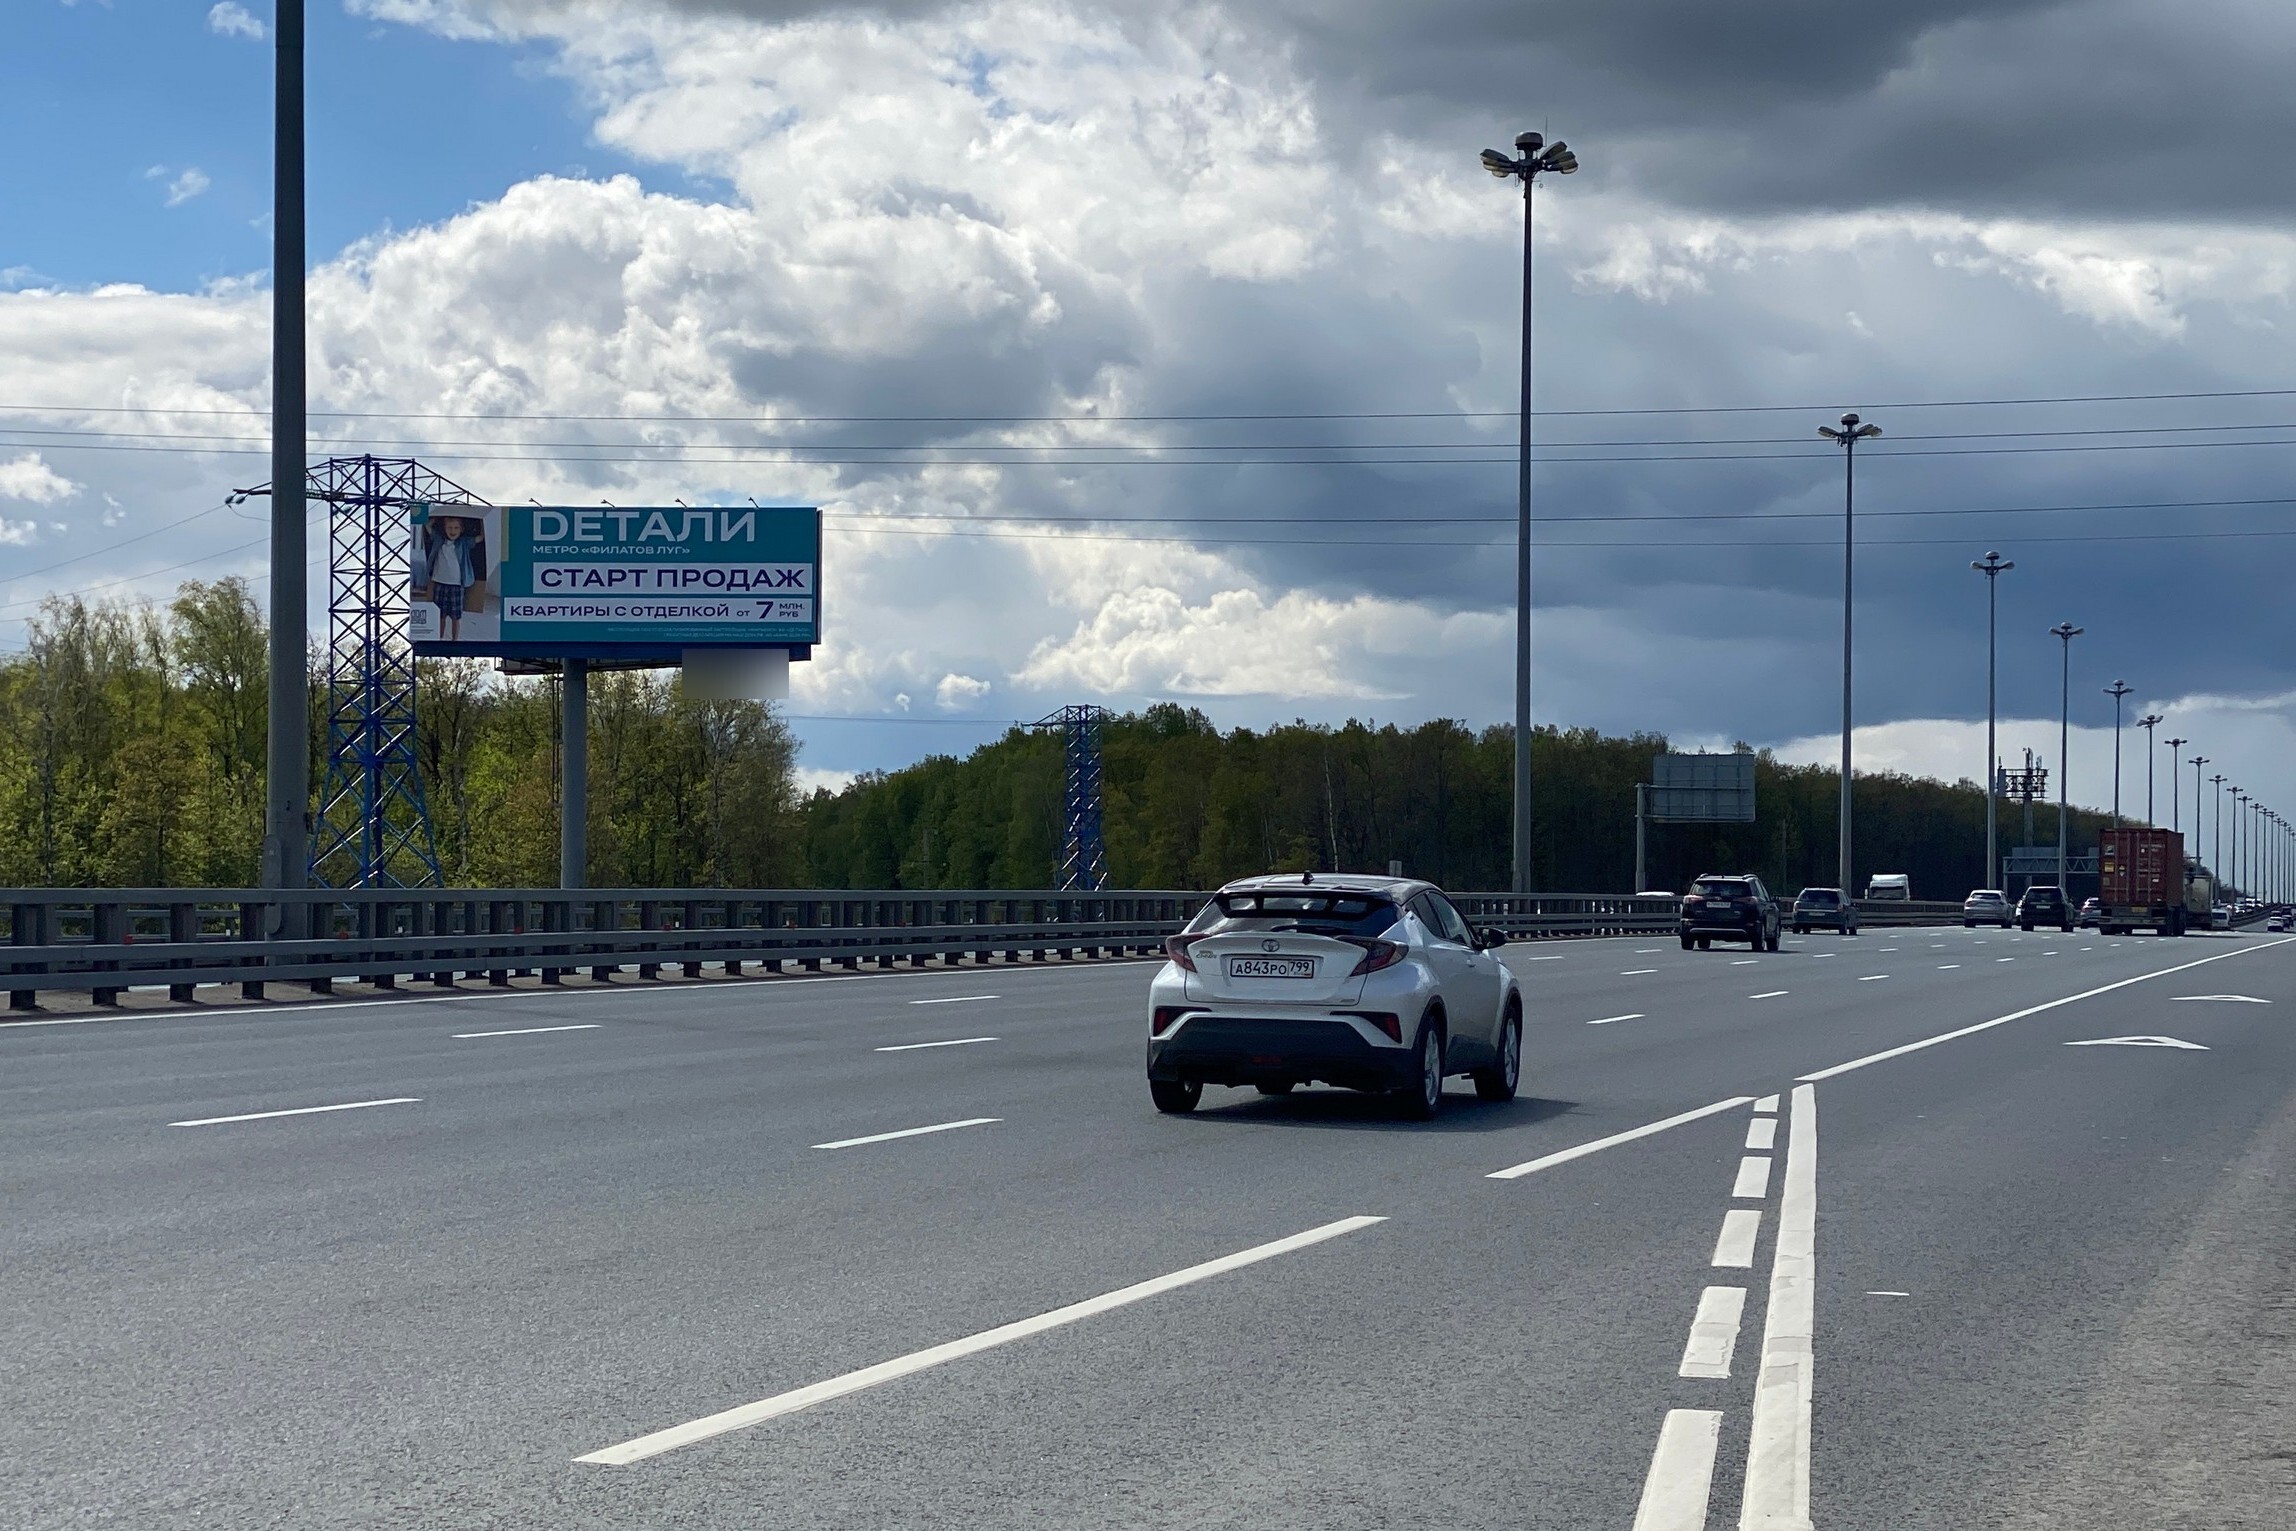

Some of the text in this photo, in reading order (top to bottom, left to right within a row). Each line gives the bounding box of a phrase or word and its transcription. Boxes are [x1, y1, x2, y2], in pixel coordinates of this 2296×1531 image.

[532, 545, 690, 555] МЕТРО «ФИЛАТОВ ЛУГ»
[540, 568, 805, 592] СТАРТ ПРОДАЖ
[510, 605, 610, 617] КВАРТИРЫ
[614, 606, 627, 617] С
[631, 603, 729, 619] ОТДЕЛКОЙ
[756, 601, 774, 619] 7
[1290, 961, 1310, 972] 799
